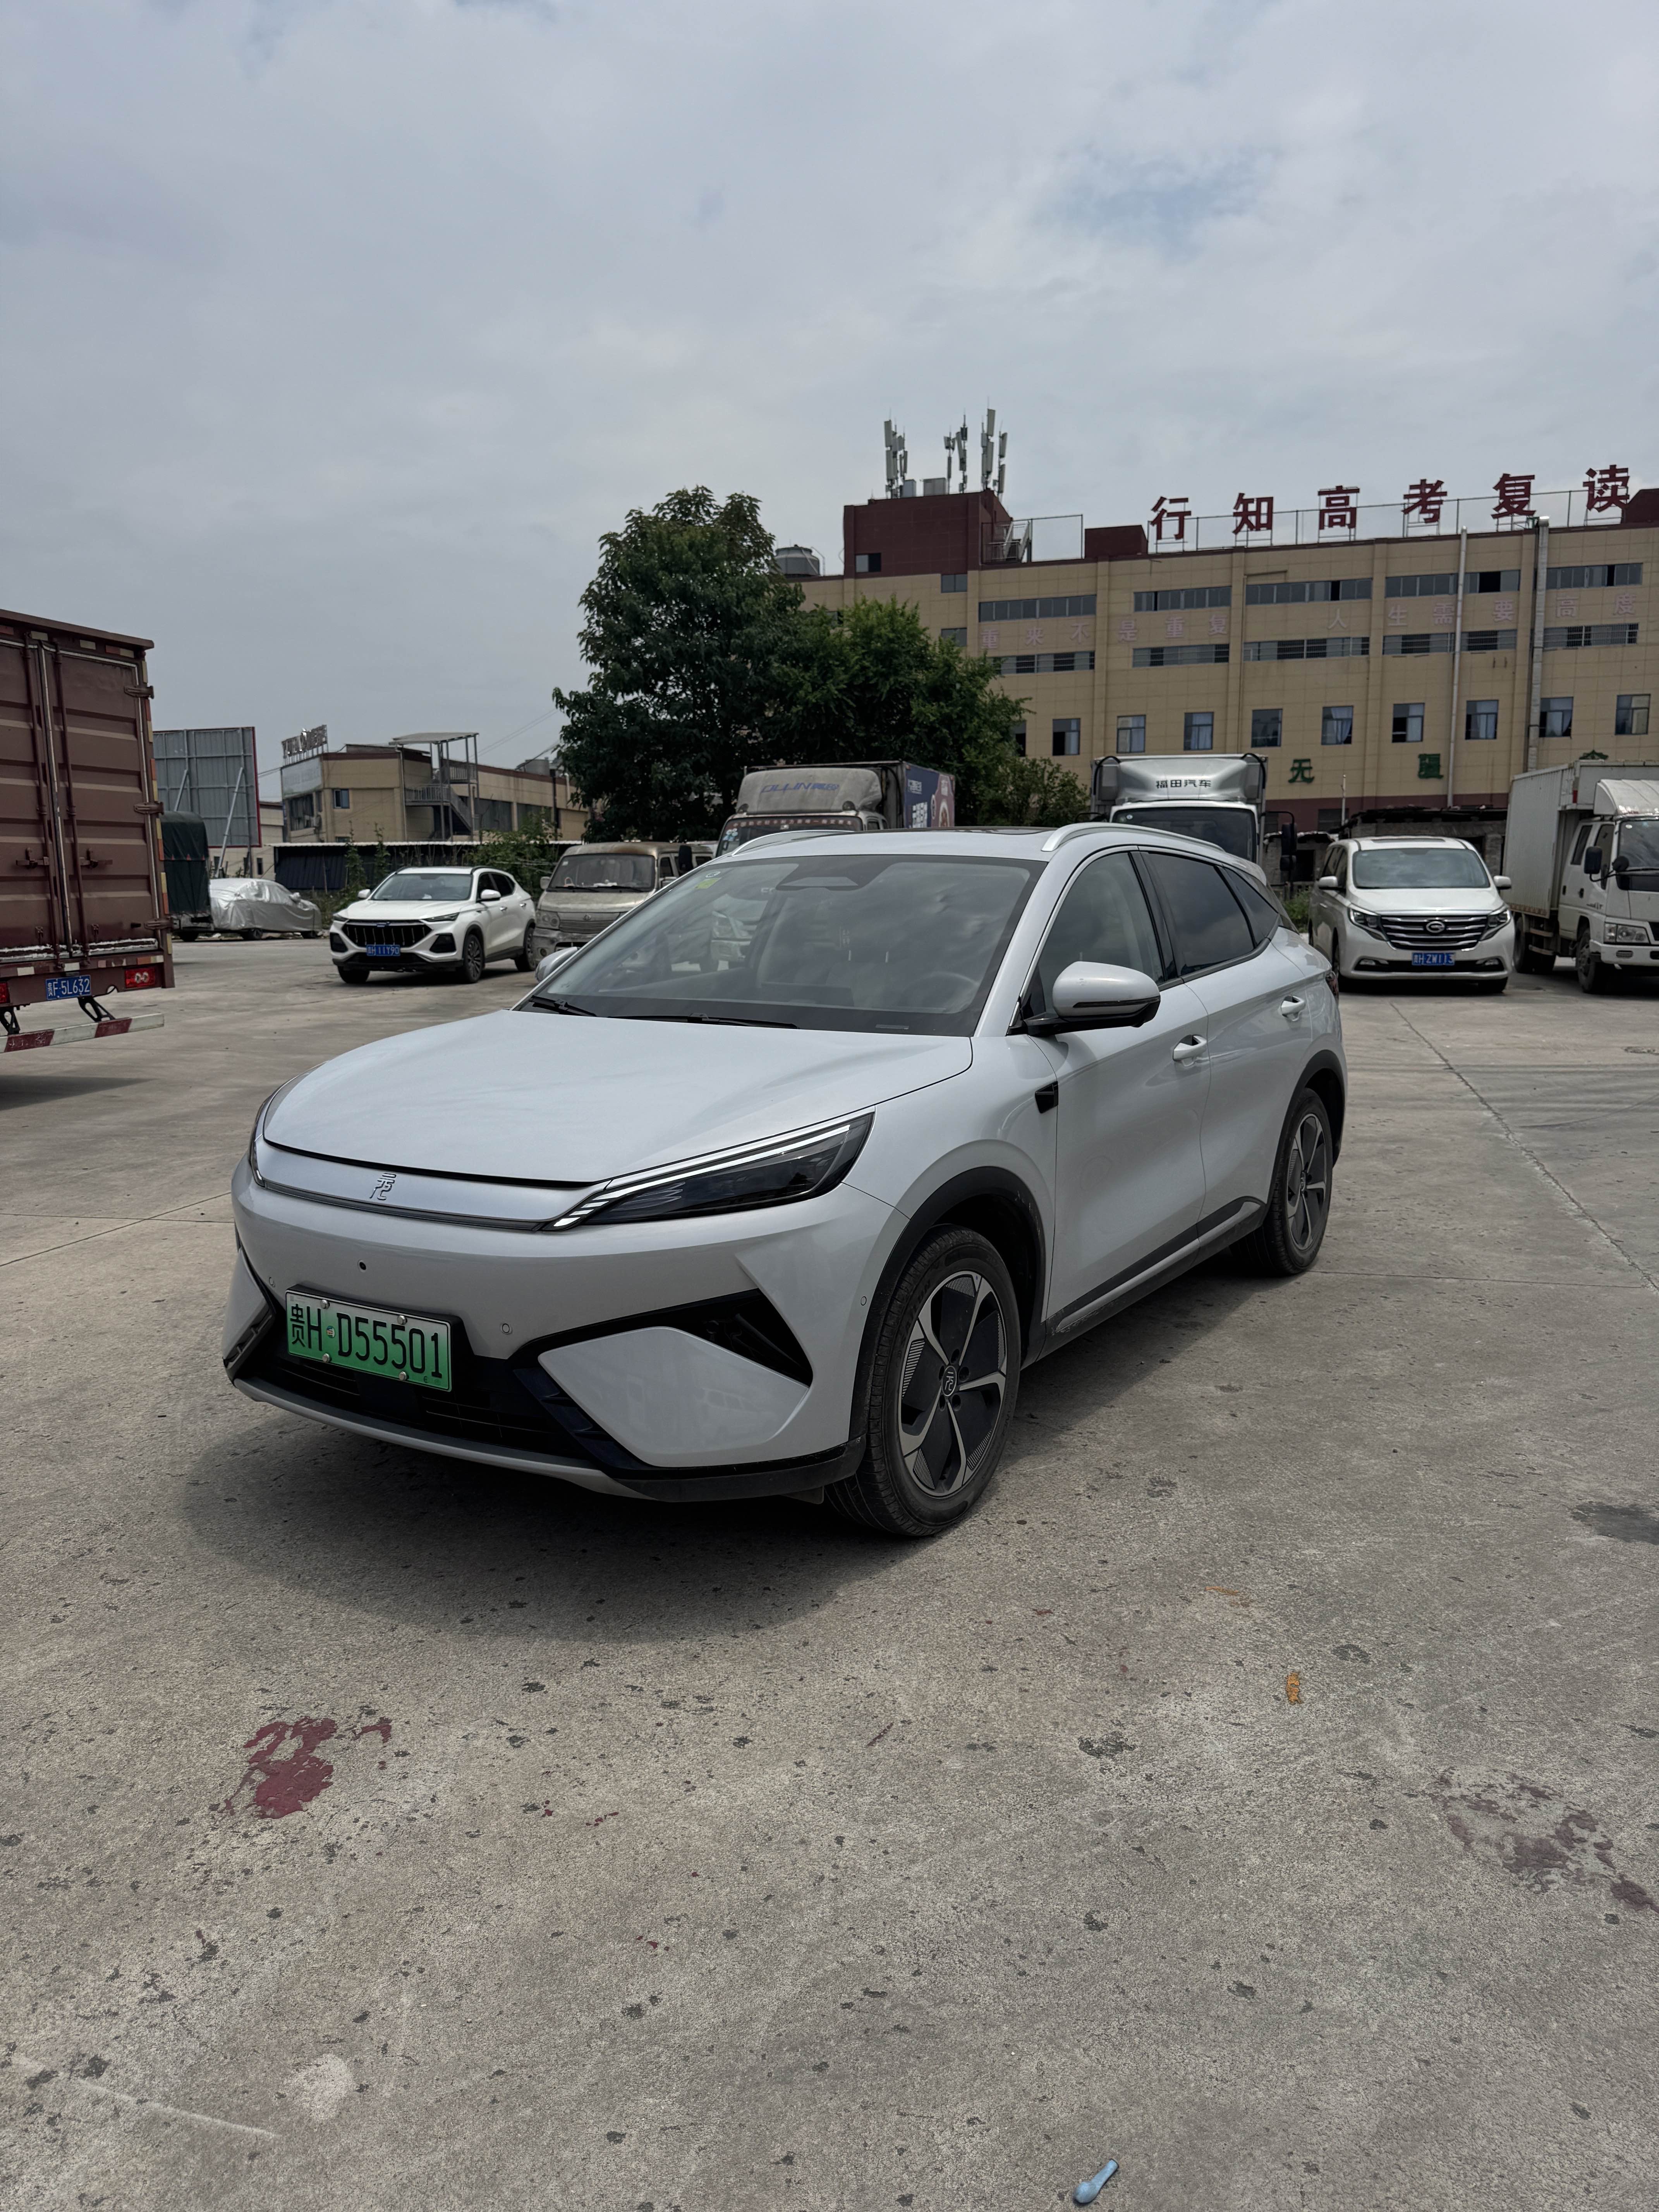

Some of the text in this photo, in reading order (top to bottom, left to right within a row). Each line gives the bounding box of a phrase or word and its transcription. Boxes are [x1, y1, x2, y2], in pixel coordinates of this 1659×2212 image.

[1151, 465, 1630, 540] 行知高考复读
[1327, 592, 1637, 630] 人生需要高度
[981, 615, 1228, 649] 重来不是重复
[1156, 779, 1211, 789] 福田汽车
